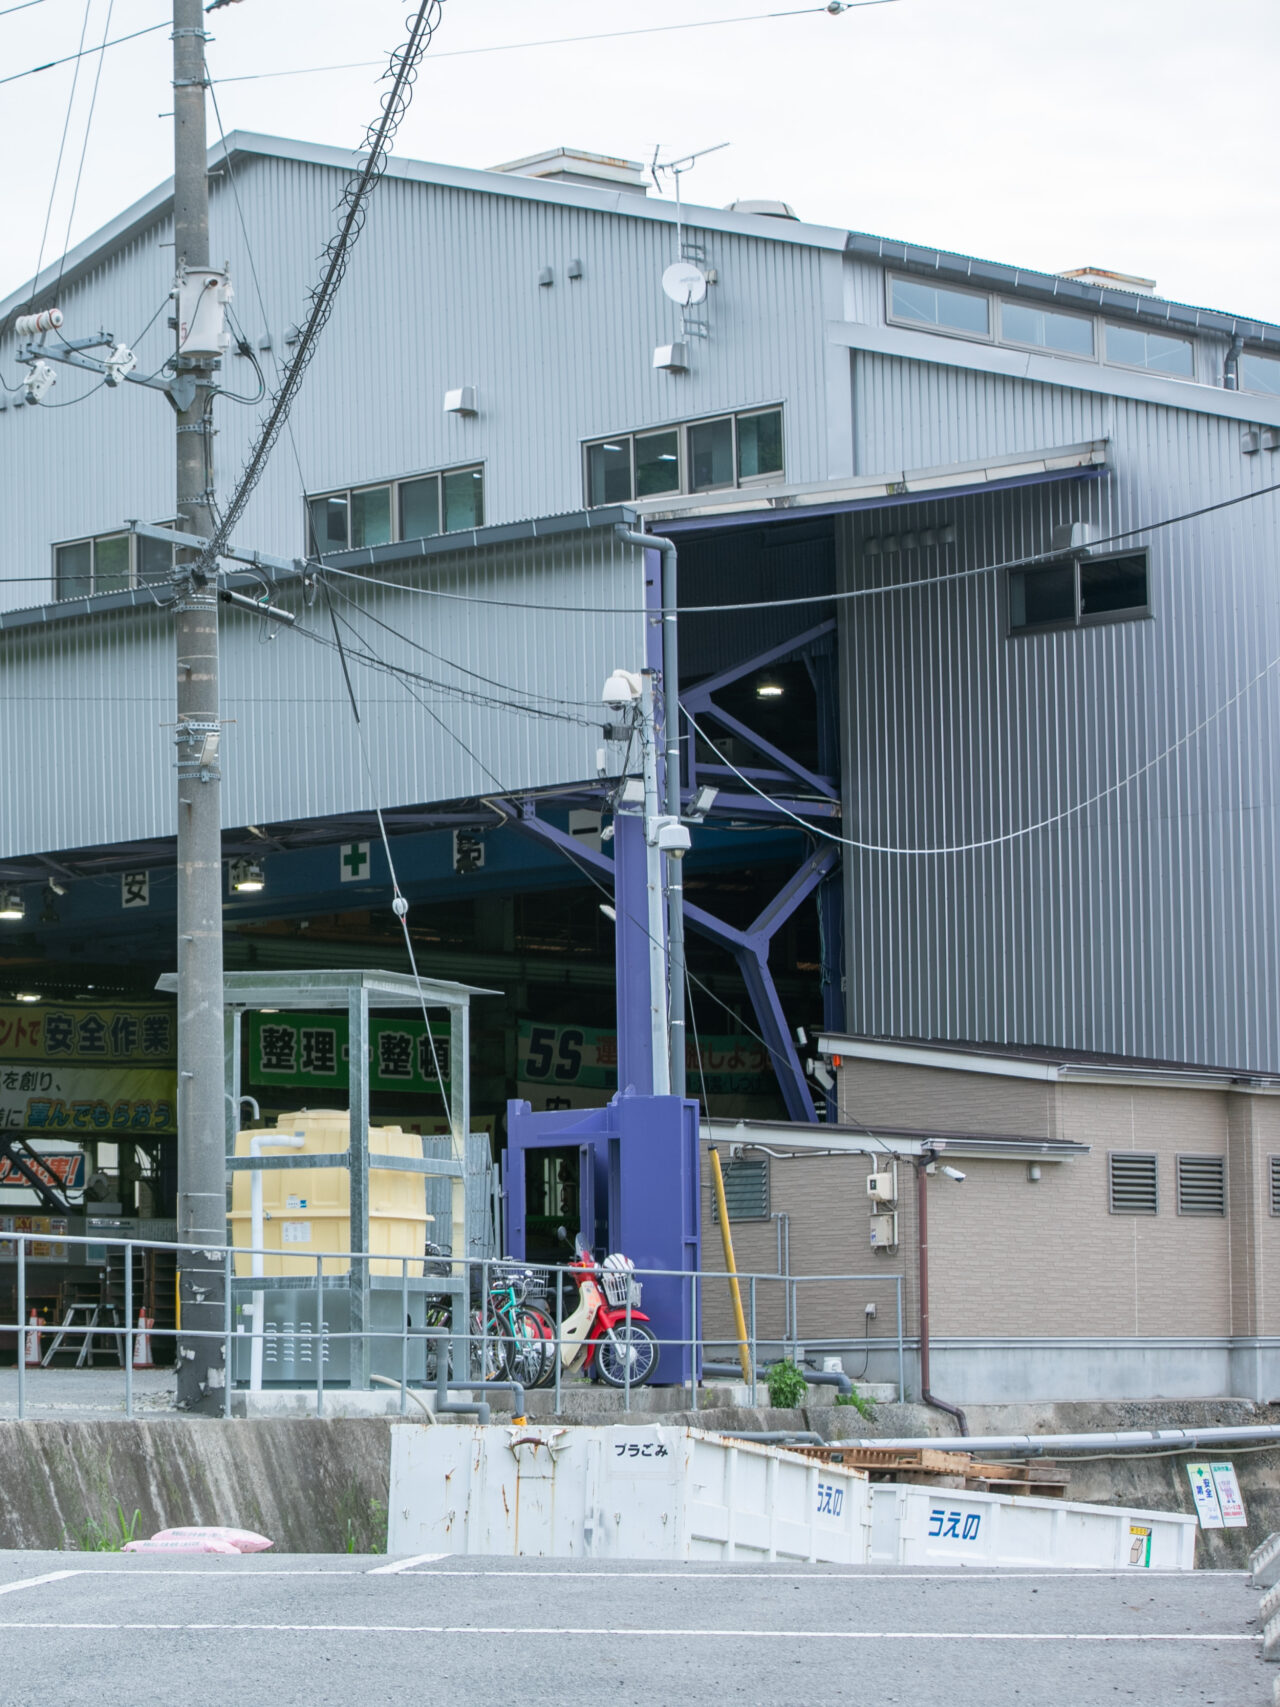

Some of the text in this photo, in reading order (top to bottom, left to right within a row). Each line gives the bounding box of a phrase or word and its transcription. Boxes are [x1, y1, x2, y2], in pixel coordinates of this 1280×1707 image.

[526, 1027, 584, 1080] 5S
[817, 1484, 843, 1517] うえの
[928, 1509, 981, 1541] うえの
